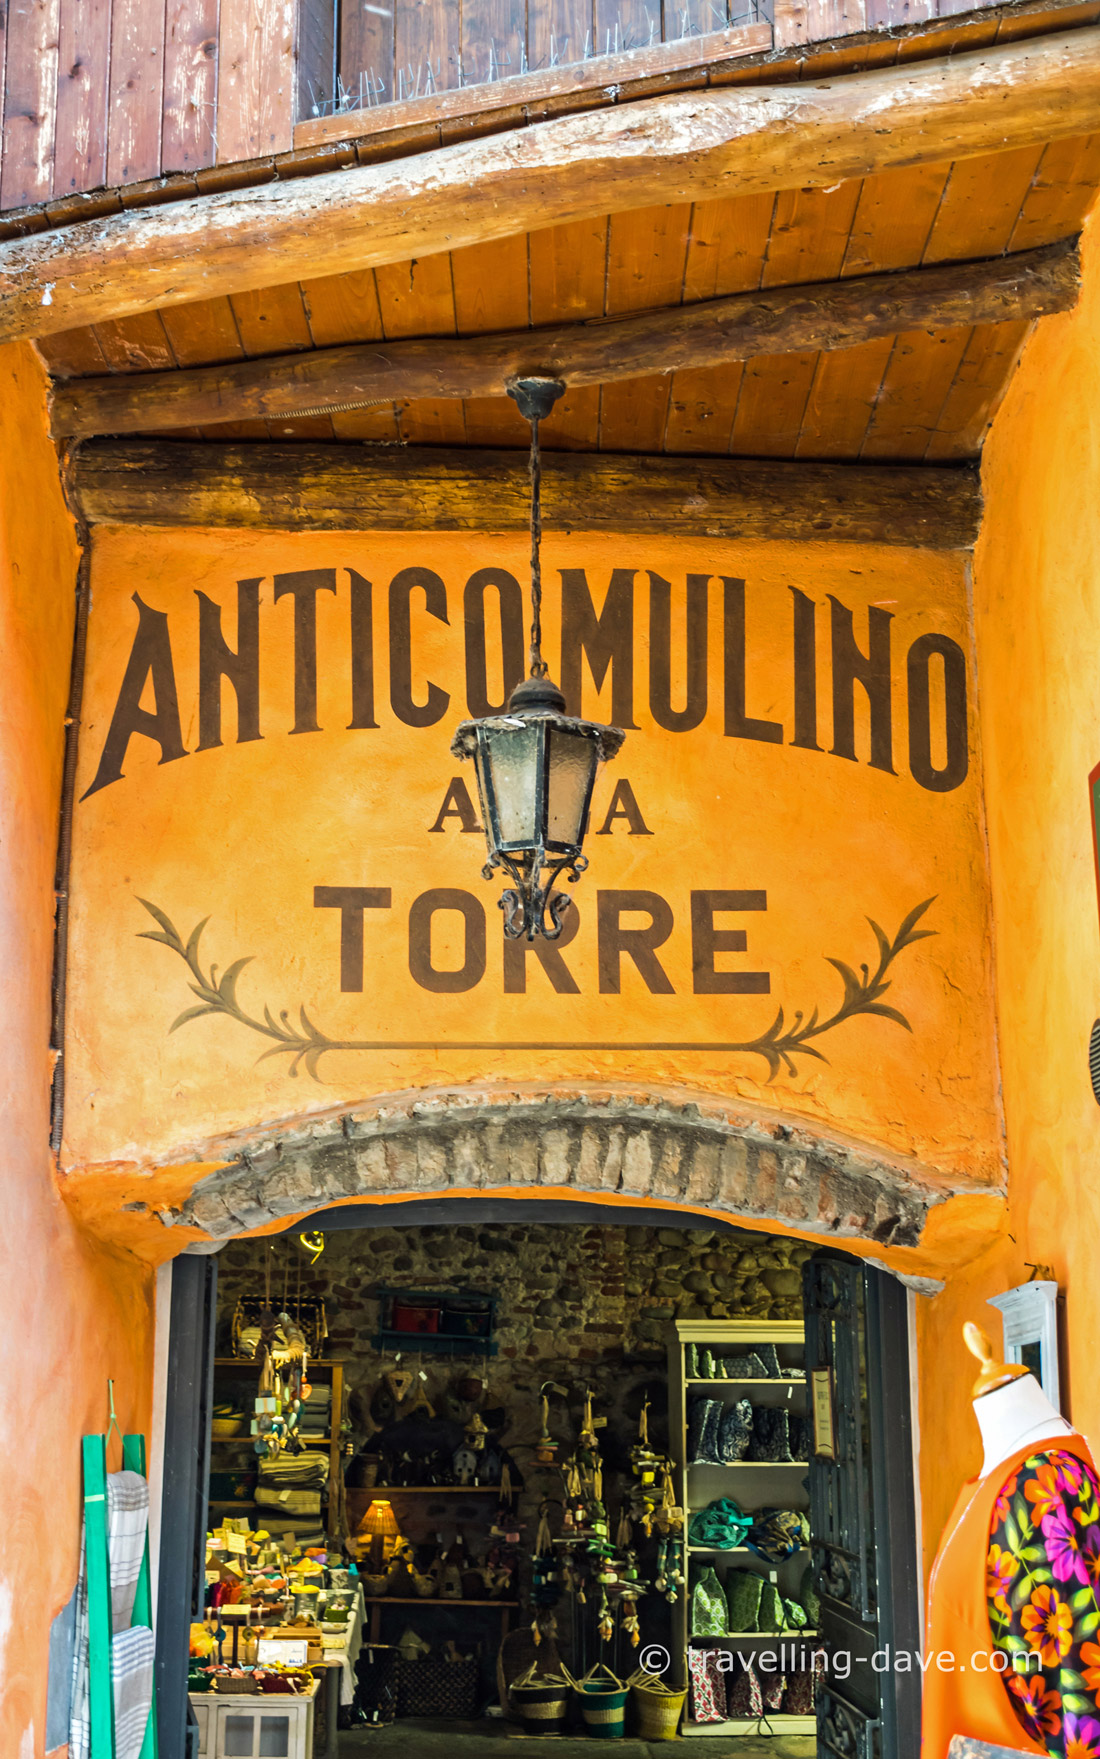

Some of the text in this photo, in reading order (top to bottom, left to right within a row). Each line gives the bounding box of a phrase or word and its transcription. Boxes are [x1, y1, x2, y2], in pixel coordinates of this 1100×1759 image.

[79, 566, 969, 804] ANTICO MULINO
[427, 776, 655, 836] AA
[313, 885, 771, 995] TORRE
